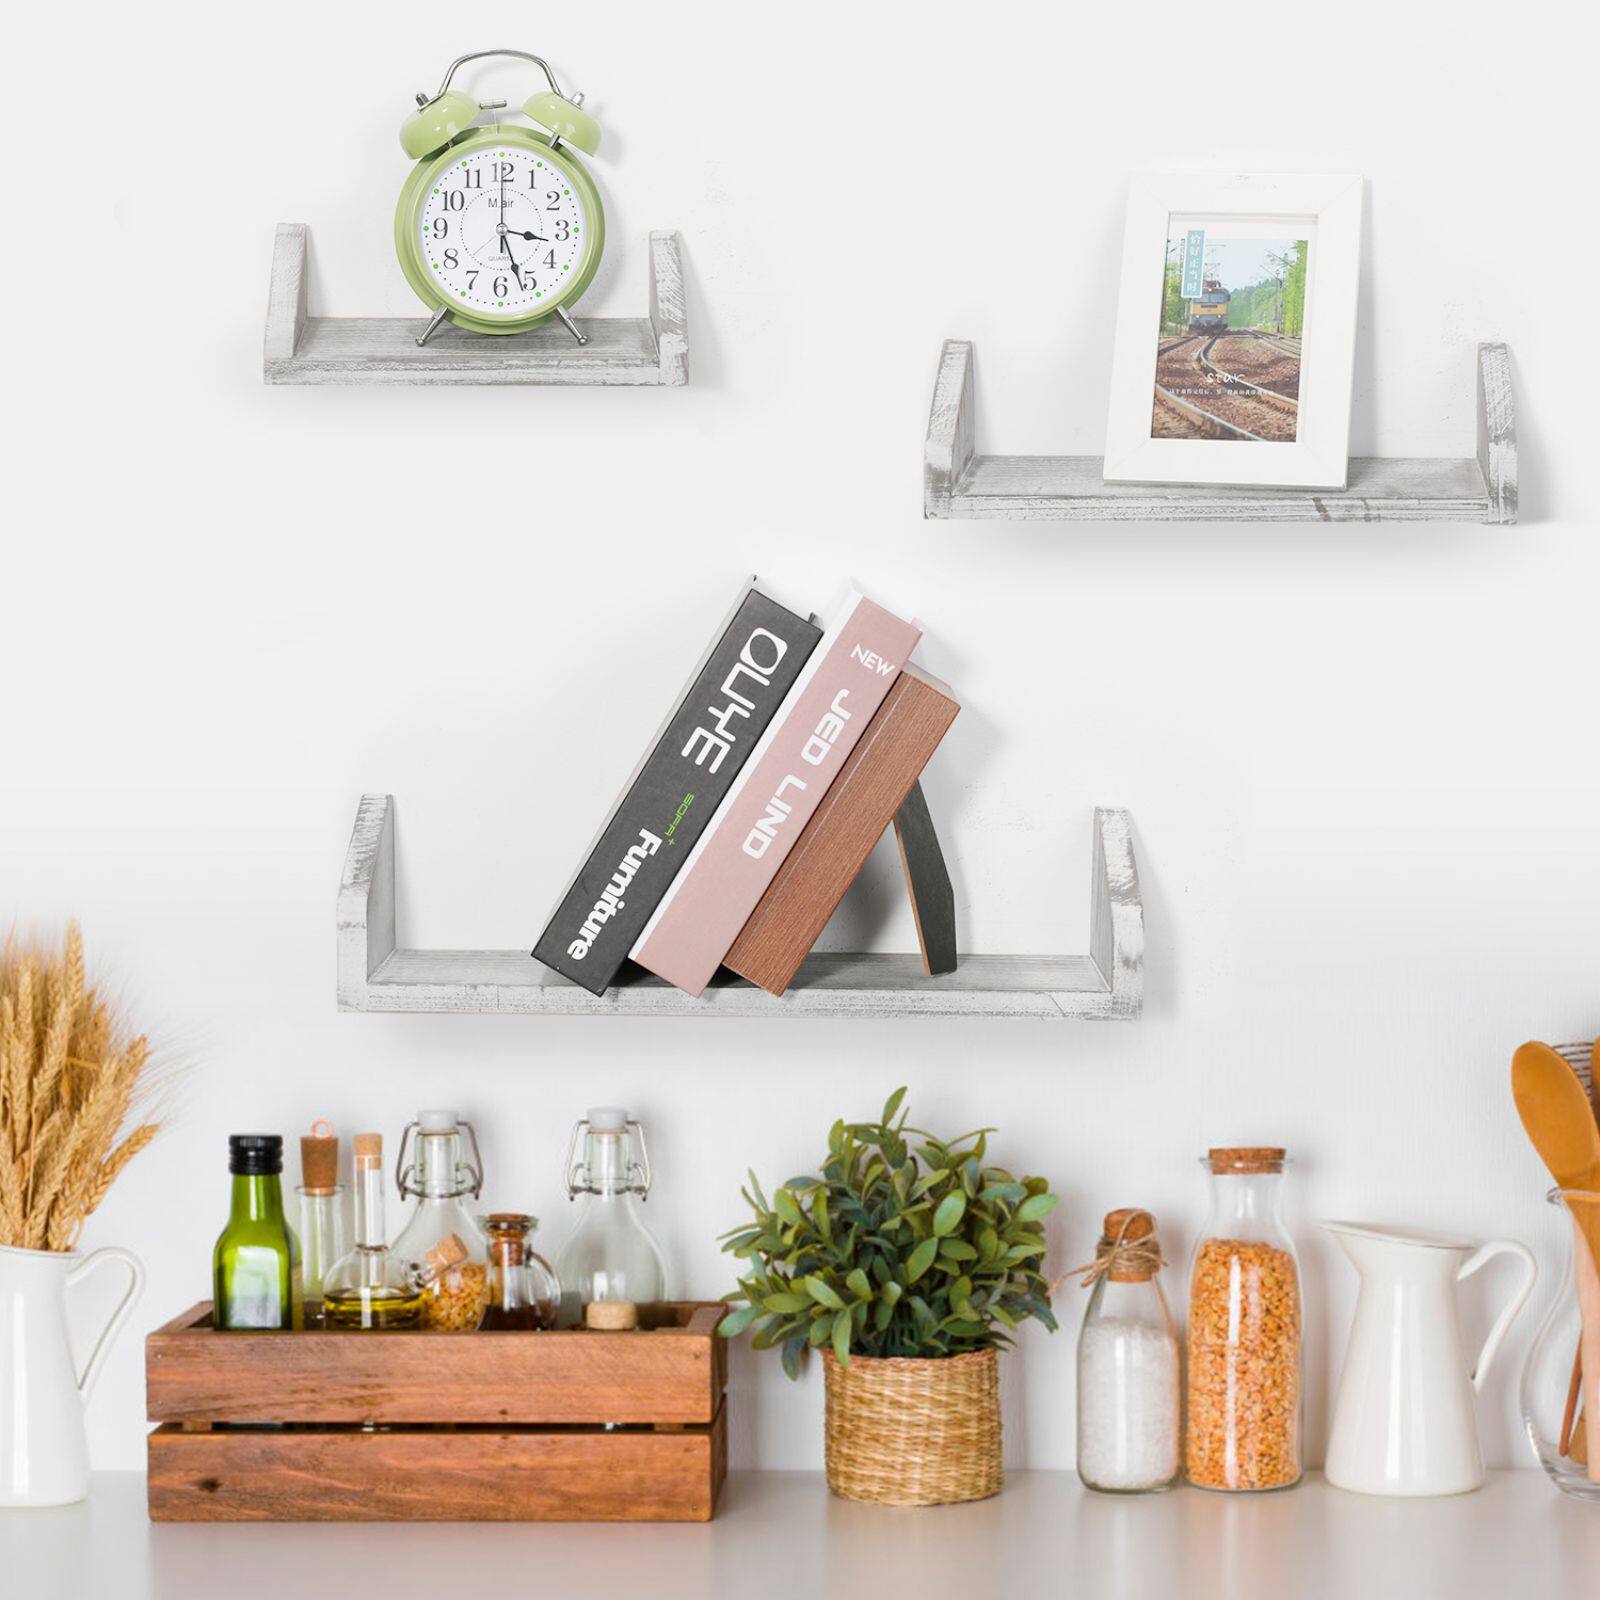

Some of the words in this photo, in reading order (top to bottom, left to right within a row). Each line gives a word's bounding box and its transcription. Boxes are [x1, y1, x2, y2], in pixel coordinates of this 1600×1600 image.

[464, 169, 482, 188] 11
[492, 163, 514, 182] 12
[529, 170, 536, 189] 1
[442, 190, 465, 211] 10
[547, 191, 560, 210] 2
[433, 218, 448, 239] 9
[555, 220, 569, 241] 3
[444, 248, 458, 269] 8
[543, 249, 556, 269] 4
[466, 271, 479, 290] 7
[494, 277, 508, 298] 6
[524, 271, 536, 290] 5
[1206, 372, 1246, 384] star
[850, 643, 895, 677] NEW
[801, 688, 852, 766] JED
[742, 774, 807, 860] LIND
[566, 828, 663, 960] Furniture
